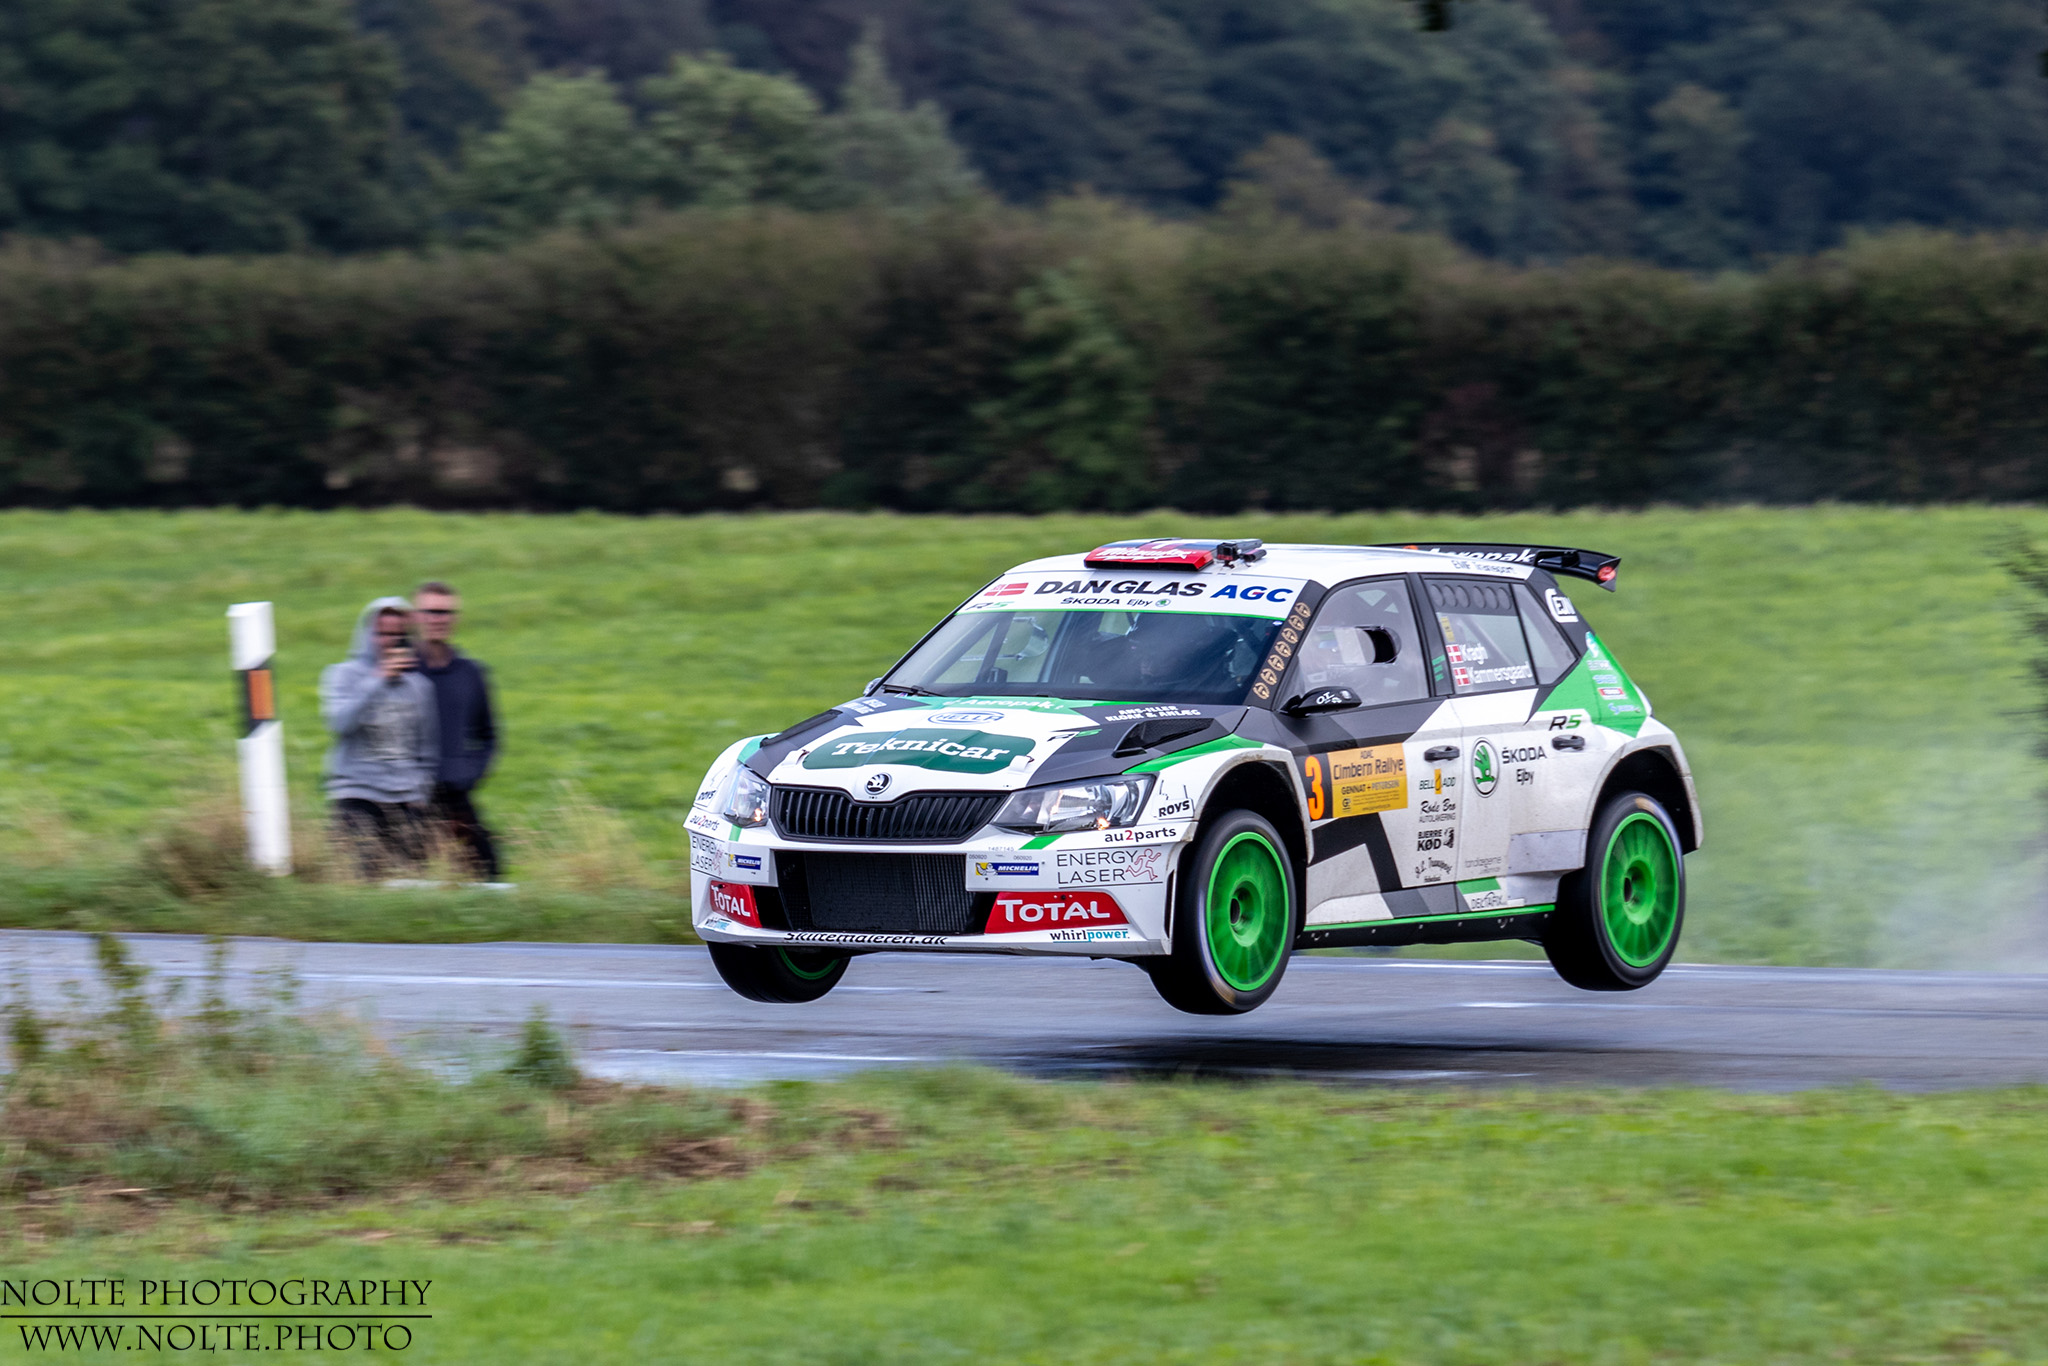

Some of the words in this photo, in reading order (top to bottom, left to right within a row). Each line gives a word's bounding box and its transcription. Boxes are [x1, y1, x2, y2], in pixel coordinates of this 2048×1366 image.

[1060, 596, 1120, 605] ŠKODA
[1127, 599, 1153, 607] Ejby
[1210, 584, 1293, 603] AGC
[937, 714, 1003, 722] HELLA
[1105, 713, 1144, 722] KLOAK
[1548, 714, 1583, 731] R5
[831, 737, 1010, 761] Teknicar
[1501, 745, 1547, 764] ŠKODA
[1333, 762, 1373, 780] Cimbern
[1375, 757, 1404, 775] Rallye
[1516, 768, 1535, 786] Ejby
[1305, 755, 1324, 820] 3
[1419, 779, 1434, 790] BELL
[1158, 800, 1190, 818] ROYS
[689, 814, 720, 832] au2parts
[1104, 826, 1177, 843] au2parts
[1418, 829, 1443, 839] BJERRE
[1416, 838, 1442, 852] KØD
[691, 853, 713, 871] LASER
[737, 857, 761, 866] MICHELIN
[1056, 849, 1138, 867] ENERGY
[1057, 868, 1126, 885] LASER
[711, 885, 750, 917] TOTAL
[996, 899, 1111, 923] TOTAL
